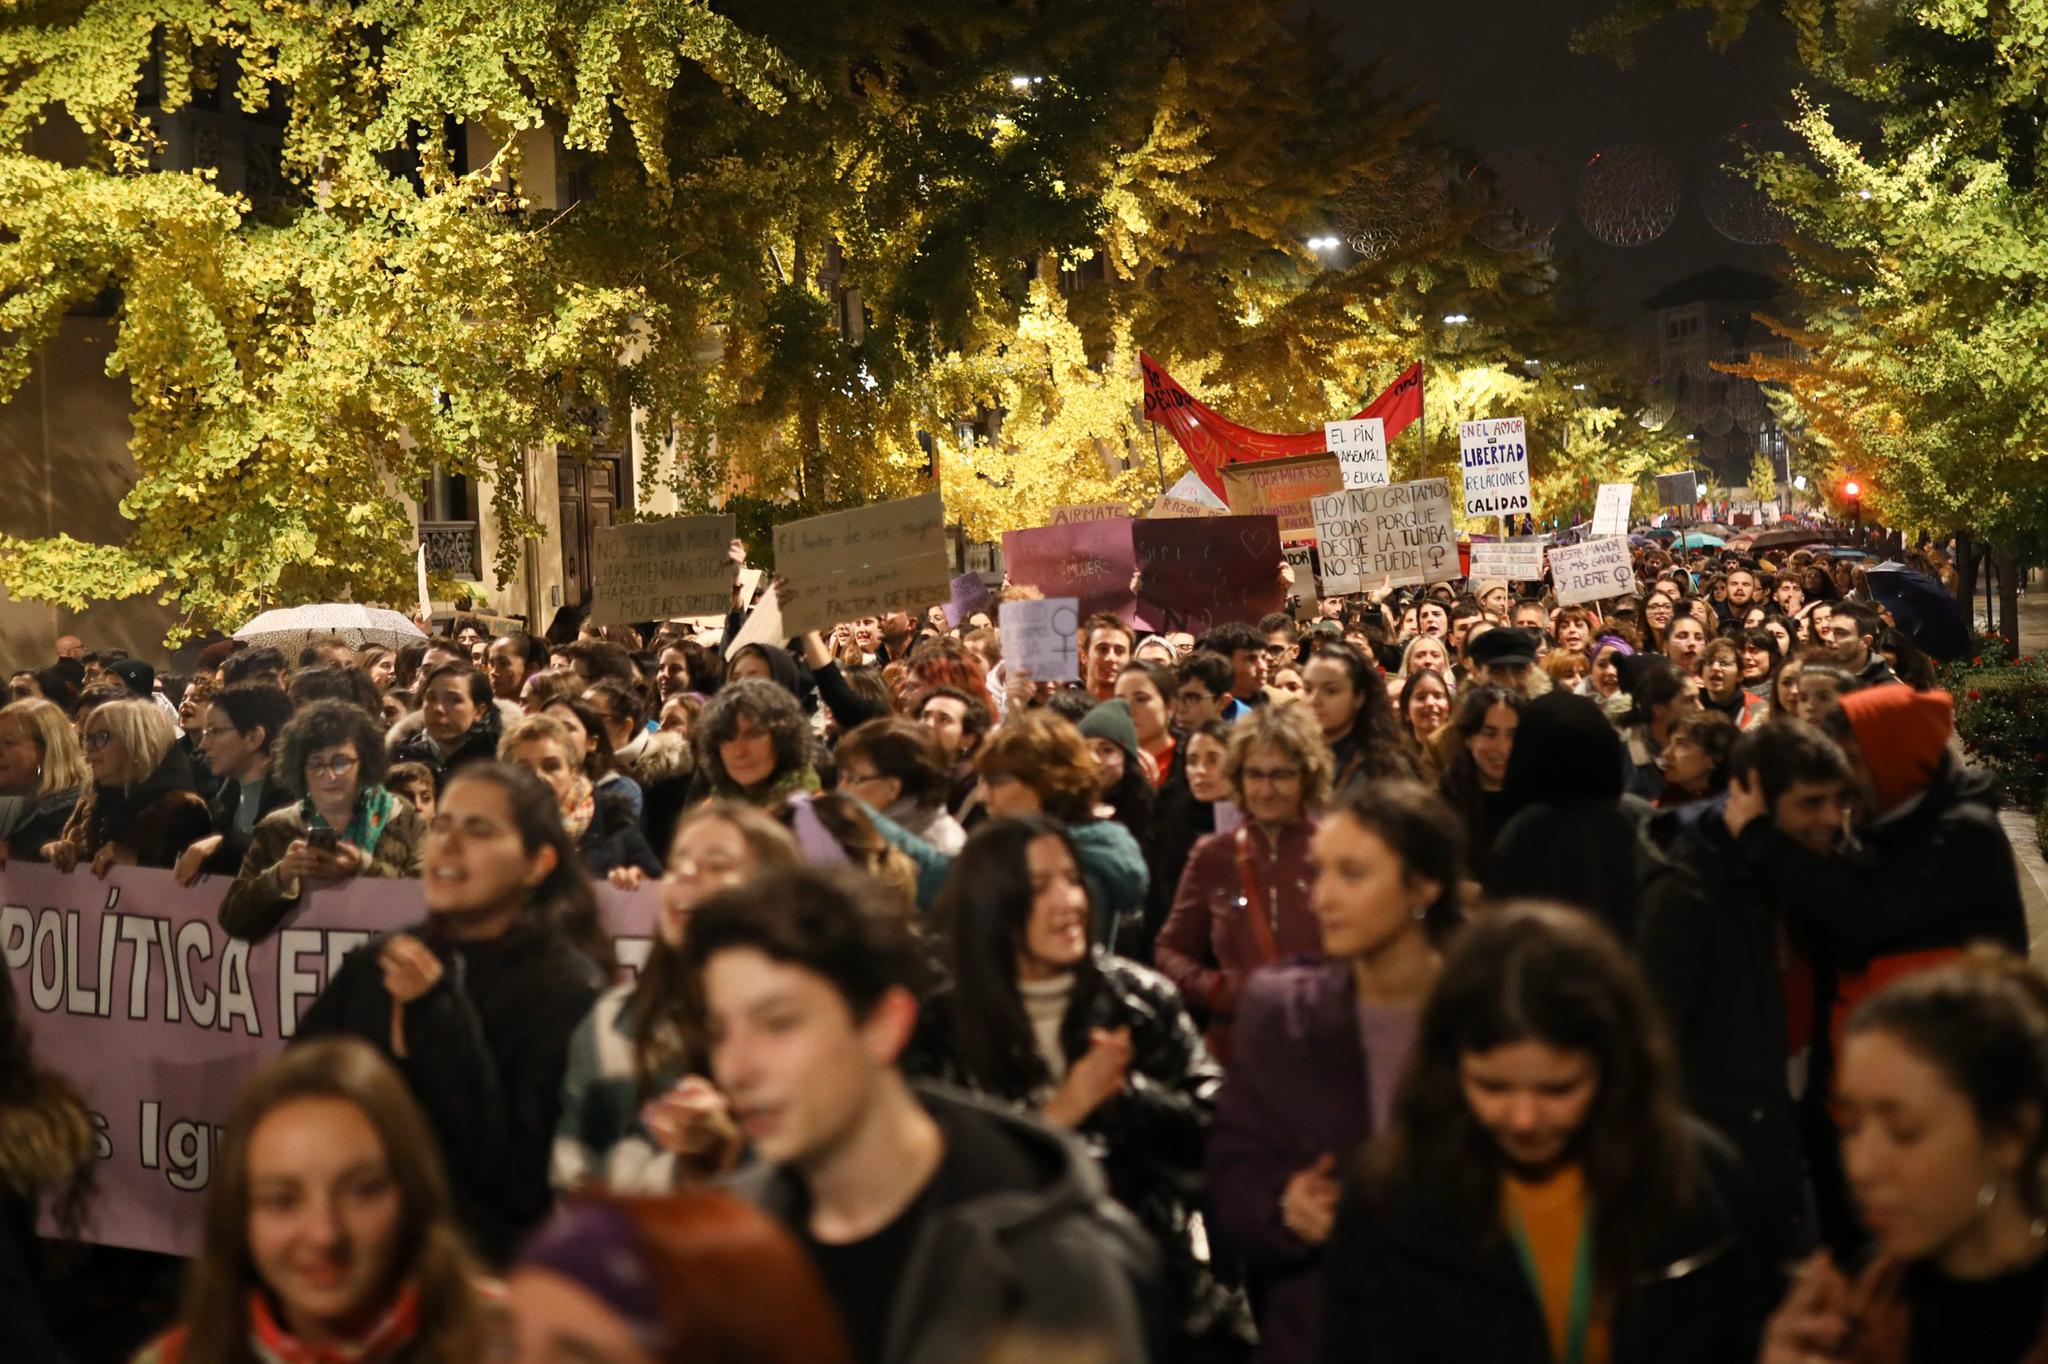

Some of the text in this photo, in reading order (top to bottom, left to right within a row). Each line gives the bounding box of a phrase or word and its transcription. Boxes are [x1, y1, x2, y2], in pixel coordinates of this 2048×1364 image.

[1332, 429, 1346, 444] EL
[1462, 421, 1523, 438] EN EL AMOR
[1336, 449, 1383, 463] ARENTAL
[1464, 444, 1524, 467] LIBERTAD
[1354, 471, 1385, 484] EDUCA
[1466, 471, 1526, 490] RELACIONES
[1314, 496, 1346, 520] HOY
[1352, 491, 1378, 514] NO
[1383, 482, 1449, 508] GRITAMOS
[1468, 496, 1528, 514] CALIDAD
[1317, 508, 1436, 539] TODAS PORQUE
[597, 539, 618, 561] NO
[686, 528, 722, 550] MUJER
[1321, 525, 1449, 558] DESDE LA TUMBA
[632, 560, 693, 584] MIENTRAS
[1066, 560, 1104, 578] MUJER
[1324, 550, 1419, 577] NO SE PUEDE
[1559, 579, 1568, 592] Y
[620, 596, 682, 619] MUJERES
[884, 588, 904, 608] DE
[0, 887, 262, 1037] POLÍTICA
